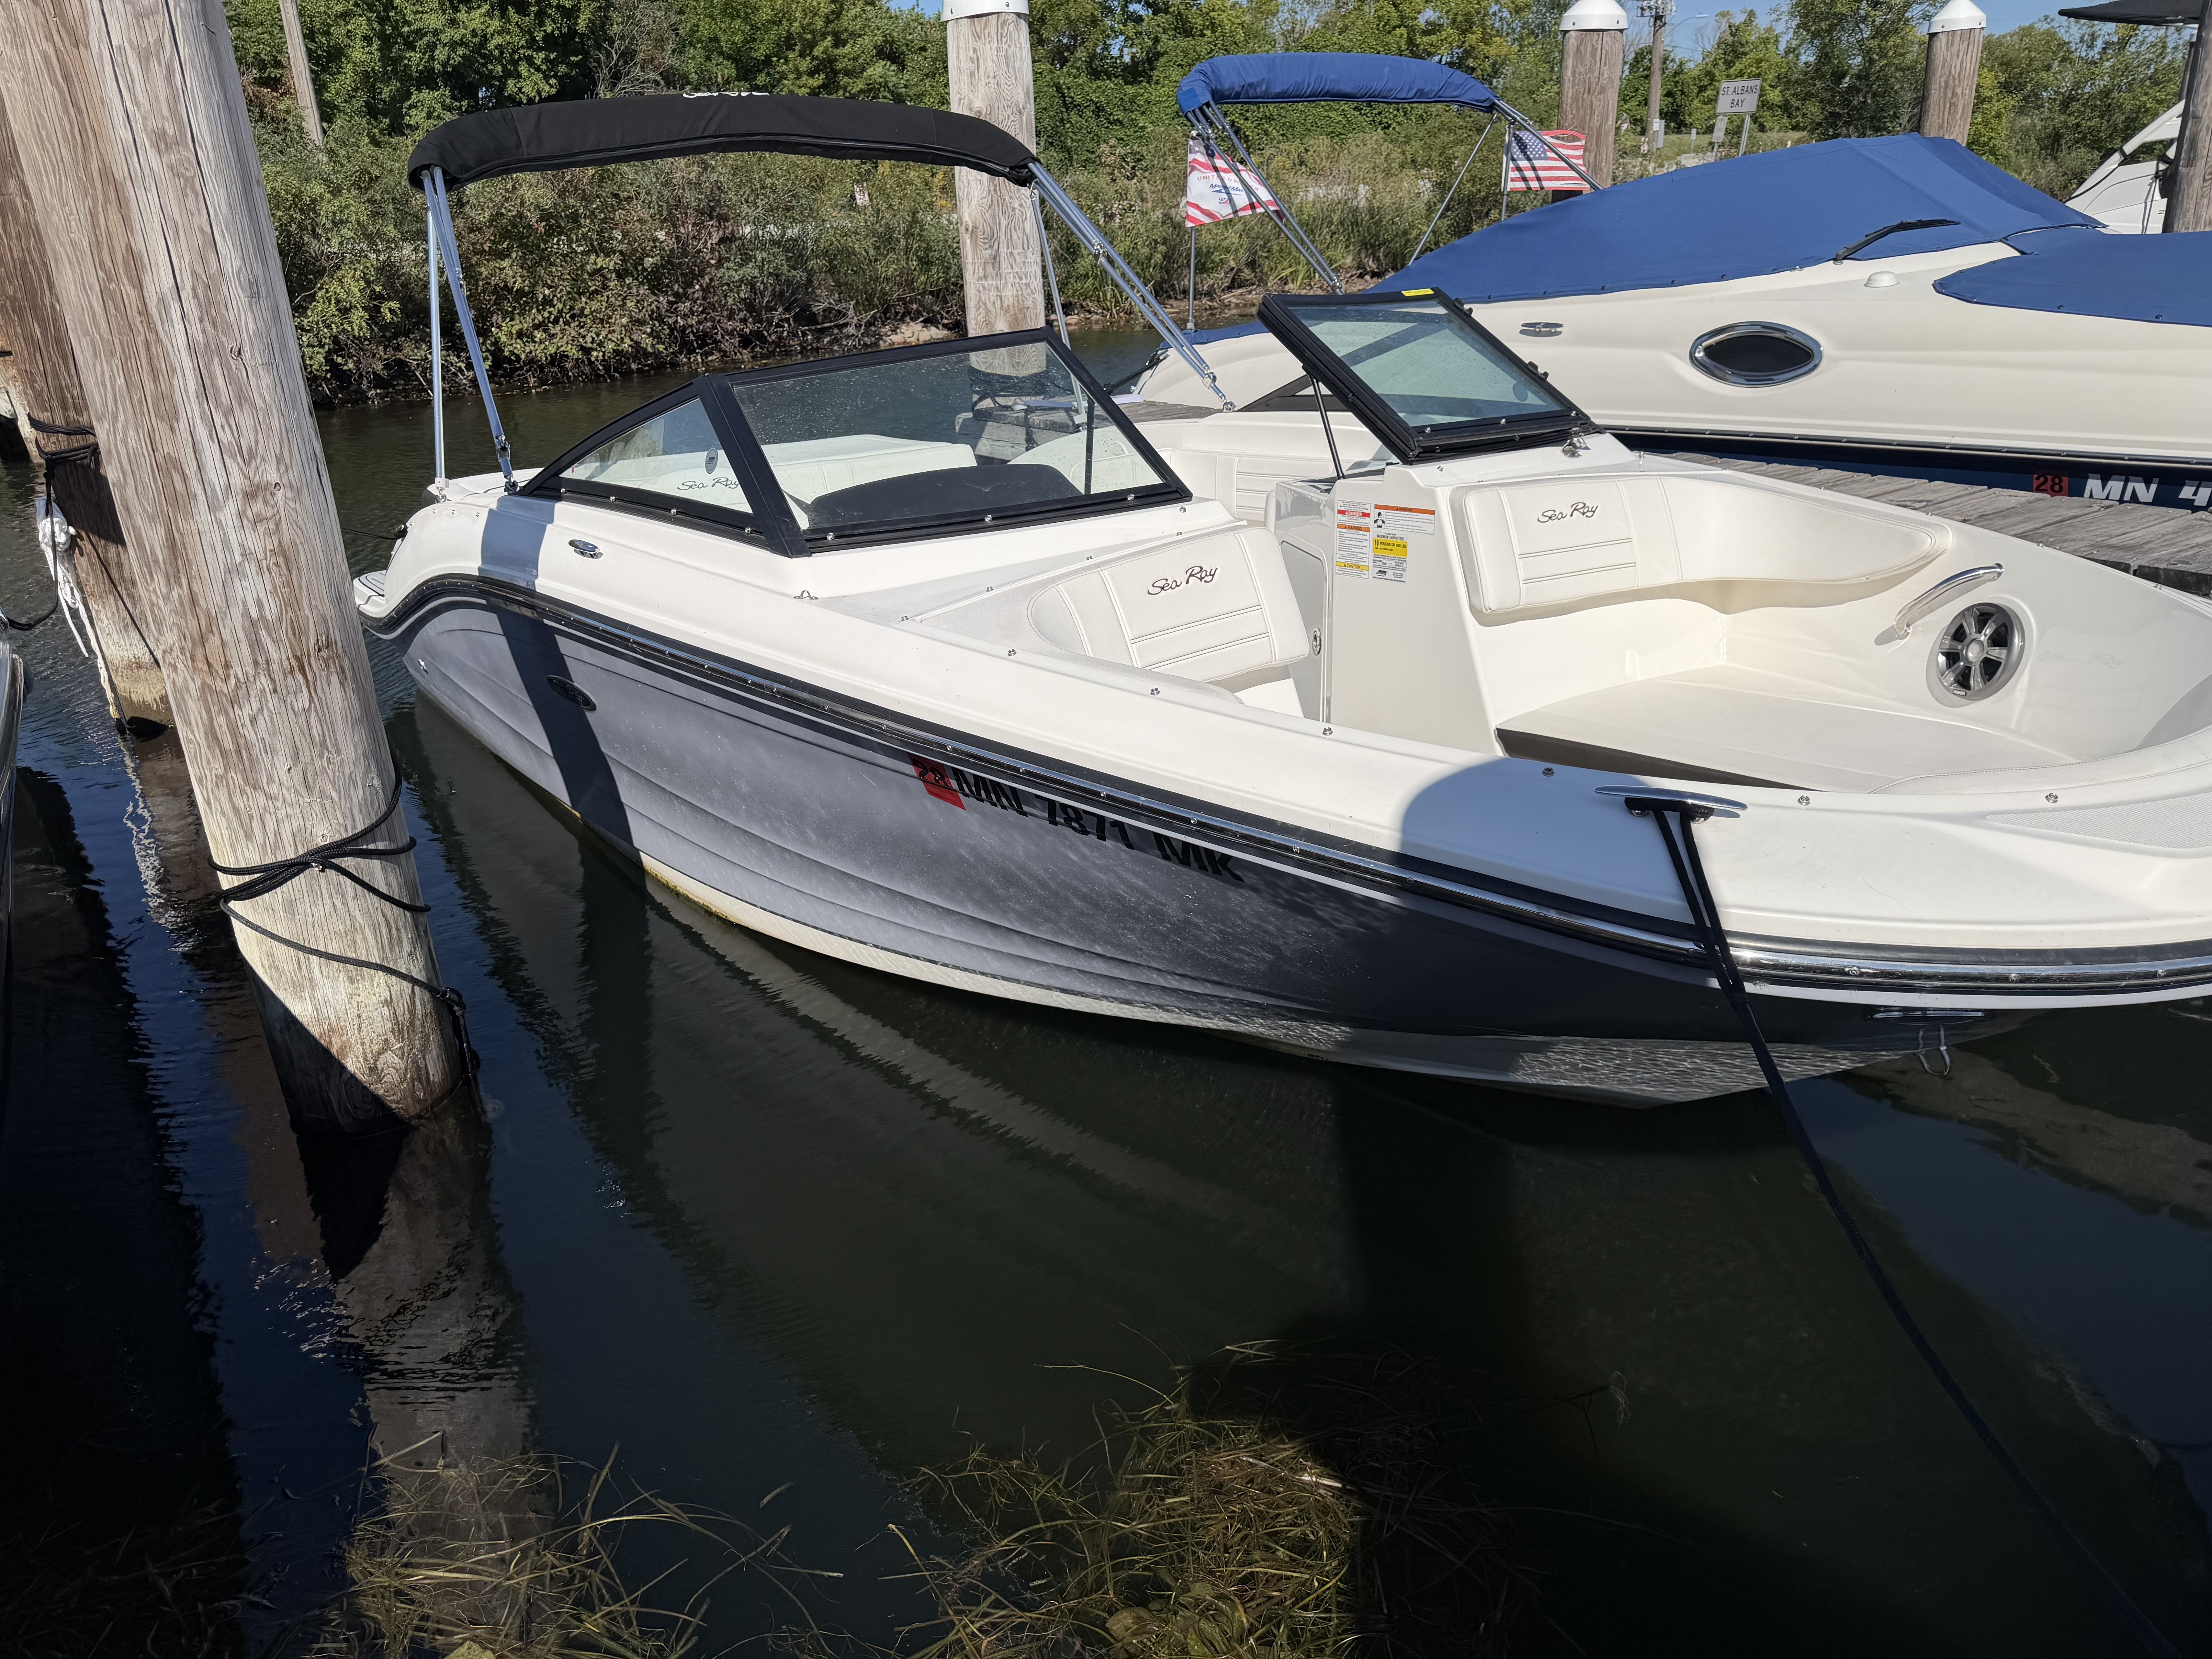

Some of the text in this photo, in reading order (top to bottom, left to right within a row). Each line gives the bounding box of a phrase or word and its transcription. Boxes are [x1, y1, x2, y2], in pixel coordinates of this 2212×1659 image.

[1721, 84, 1758, 96] ST. ALBANS
[1730, 98, 1745, 108] BAY
[677, 477, 740, 490] Sea Ray
[2035, 474, 2064, 493] 28
[2083, 473, 2160, 502] MN
[1537, 502, 1599, 523] Sea Ray
[1147, 566, 1218, 595] Sea Ray
[951, 767, 1029, 818] MN
[1034, 793, 1135, 850] 7871
[1152, 831, 1245, 883] MK
